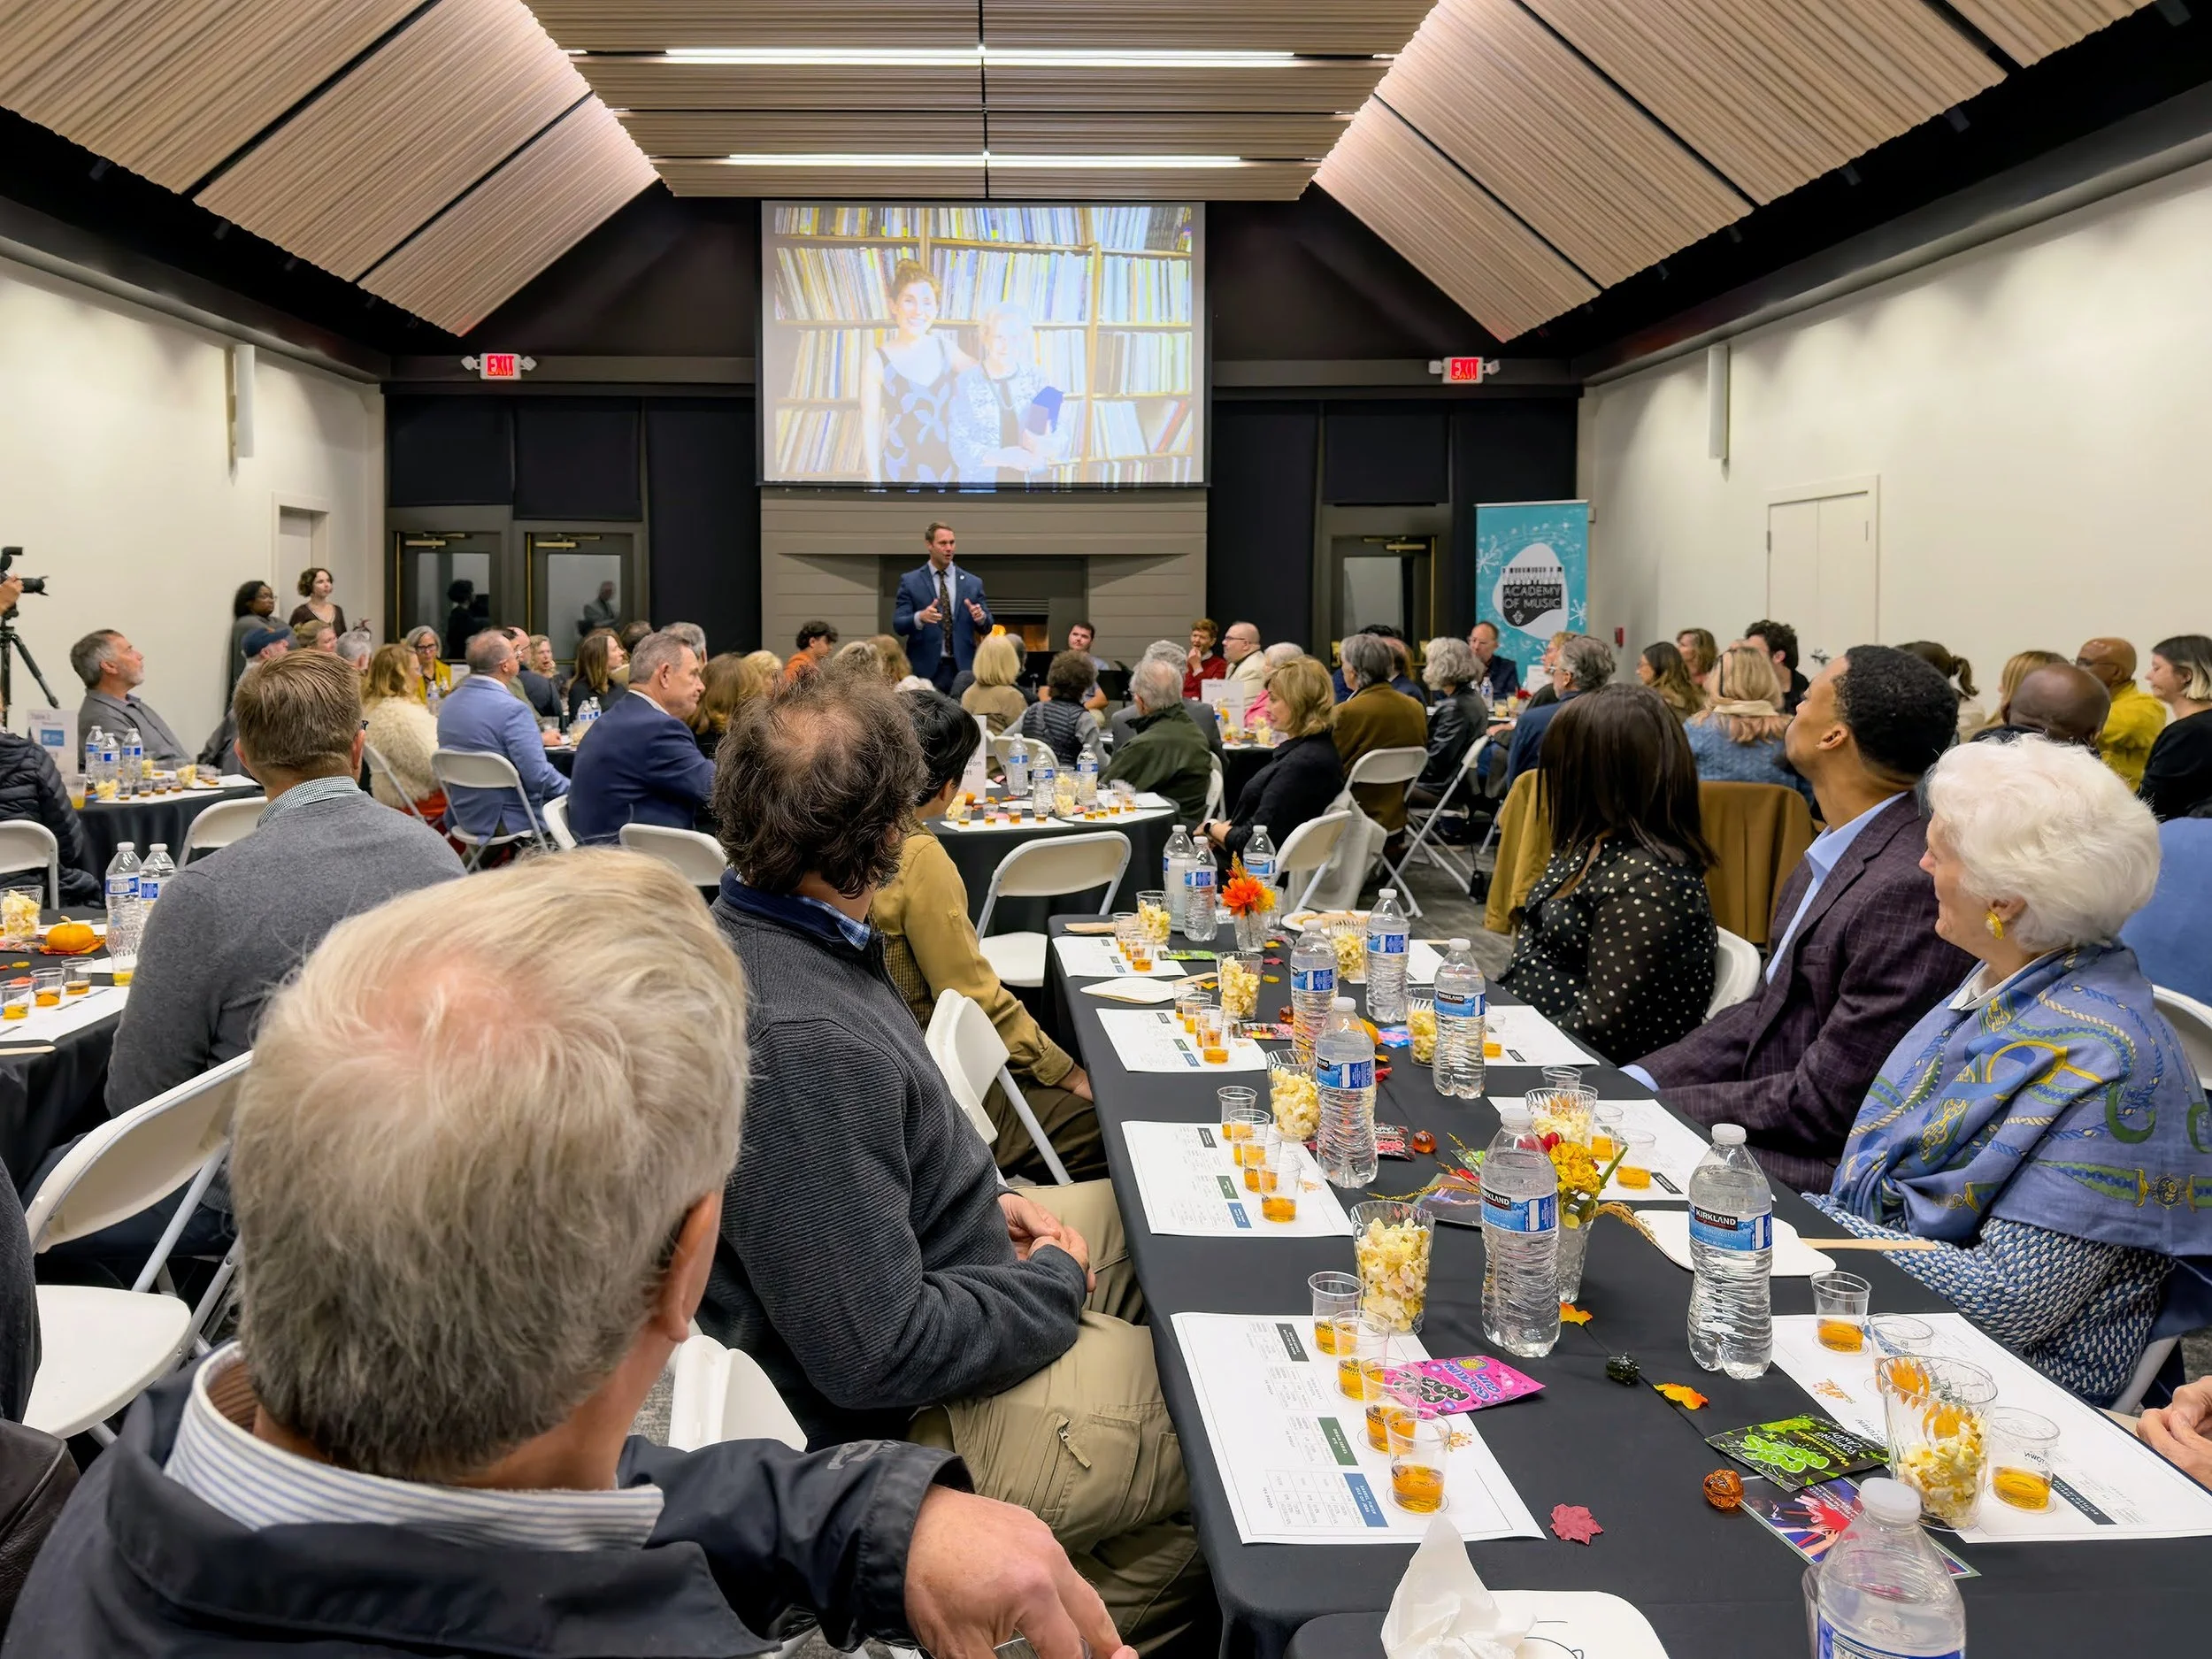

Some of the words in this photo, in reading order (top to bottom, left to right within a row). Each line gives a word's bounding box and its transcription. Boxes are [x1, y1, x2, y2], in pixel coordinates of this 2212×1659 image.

[488, 355, 514, 376] EXIT
[1451, 358, 1479, 380] EXIT
[1503, 586, 1561, 596] ACADEMY
[1504, 598, 1519, 609] OF
[1524, 598, 1561, 609] MUSIC
[1481, 1189, 1509, 1205] RKLAND
[1695, 1209, 1736, 1225] KIRKLAND
[1793, 1429, 1850, 1468] Watermelon
[1814, 1431, 1856, 1455] POPPING
[1831, 1431, 1863, 1448] CANDY
[1740, 1434, 1830, 1470] ROCKS
[1741, 1450, 1806, 1473] POP
